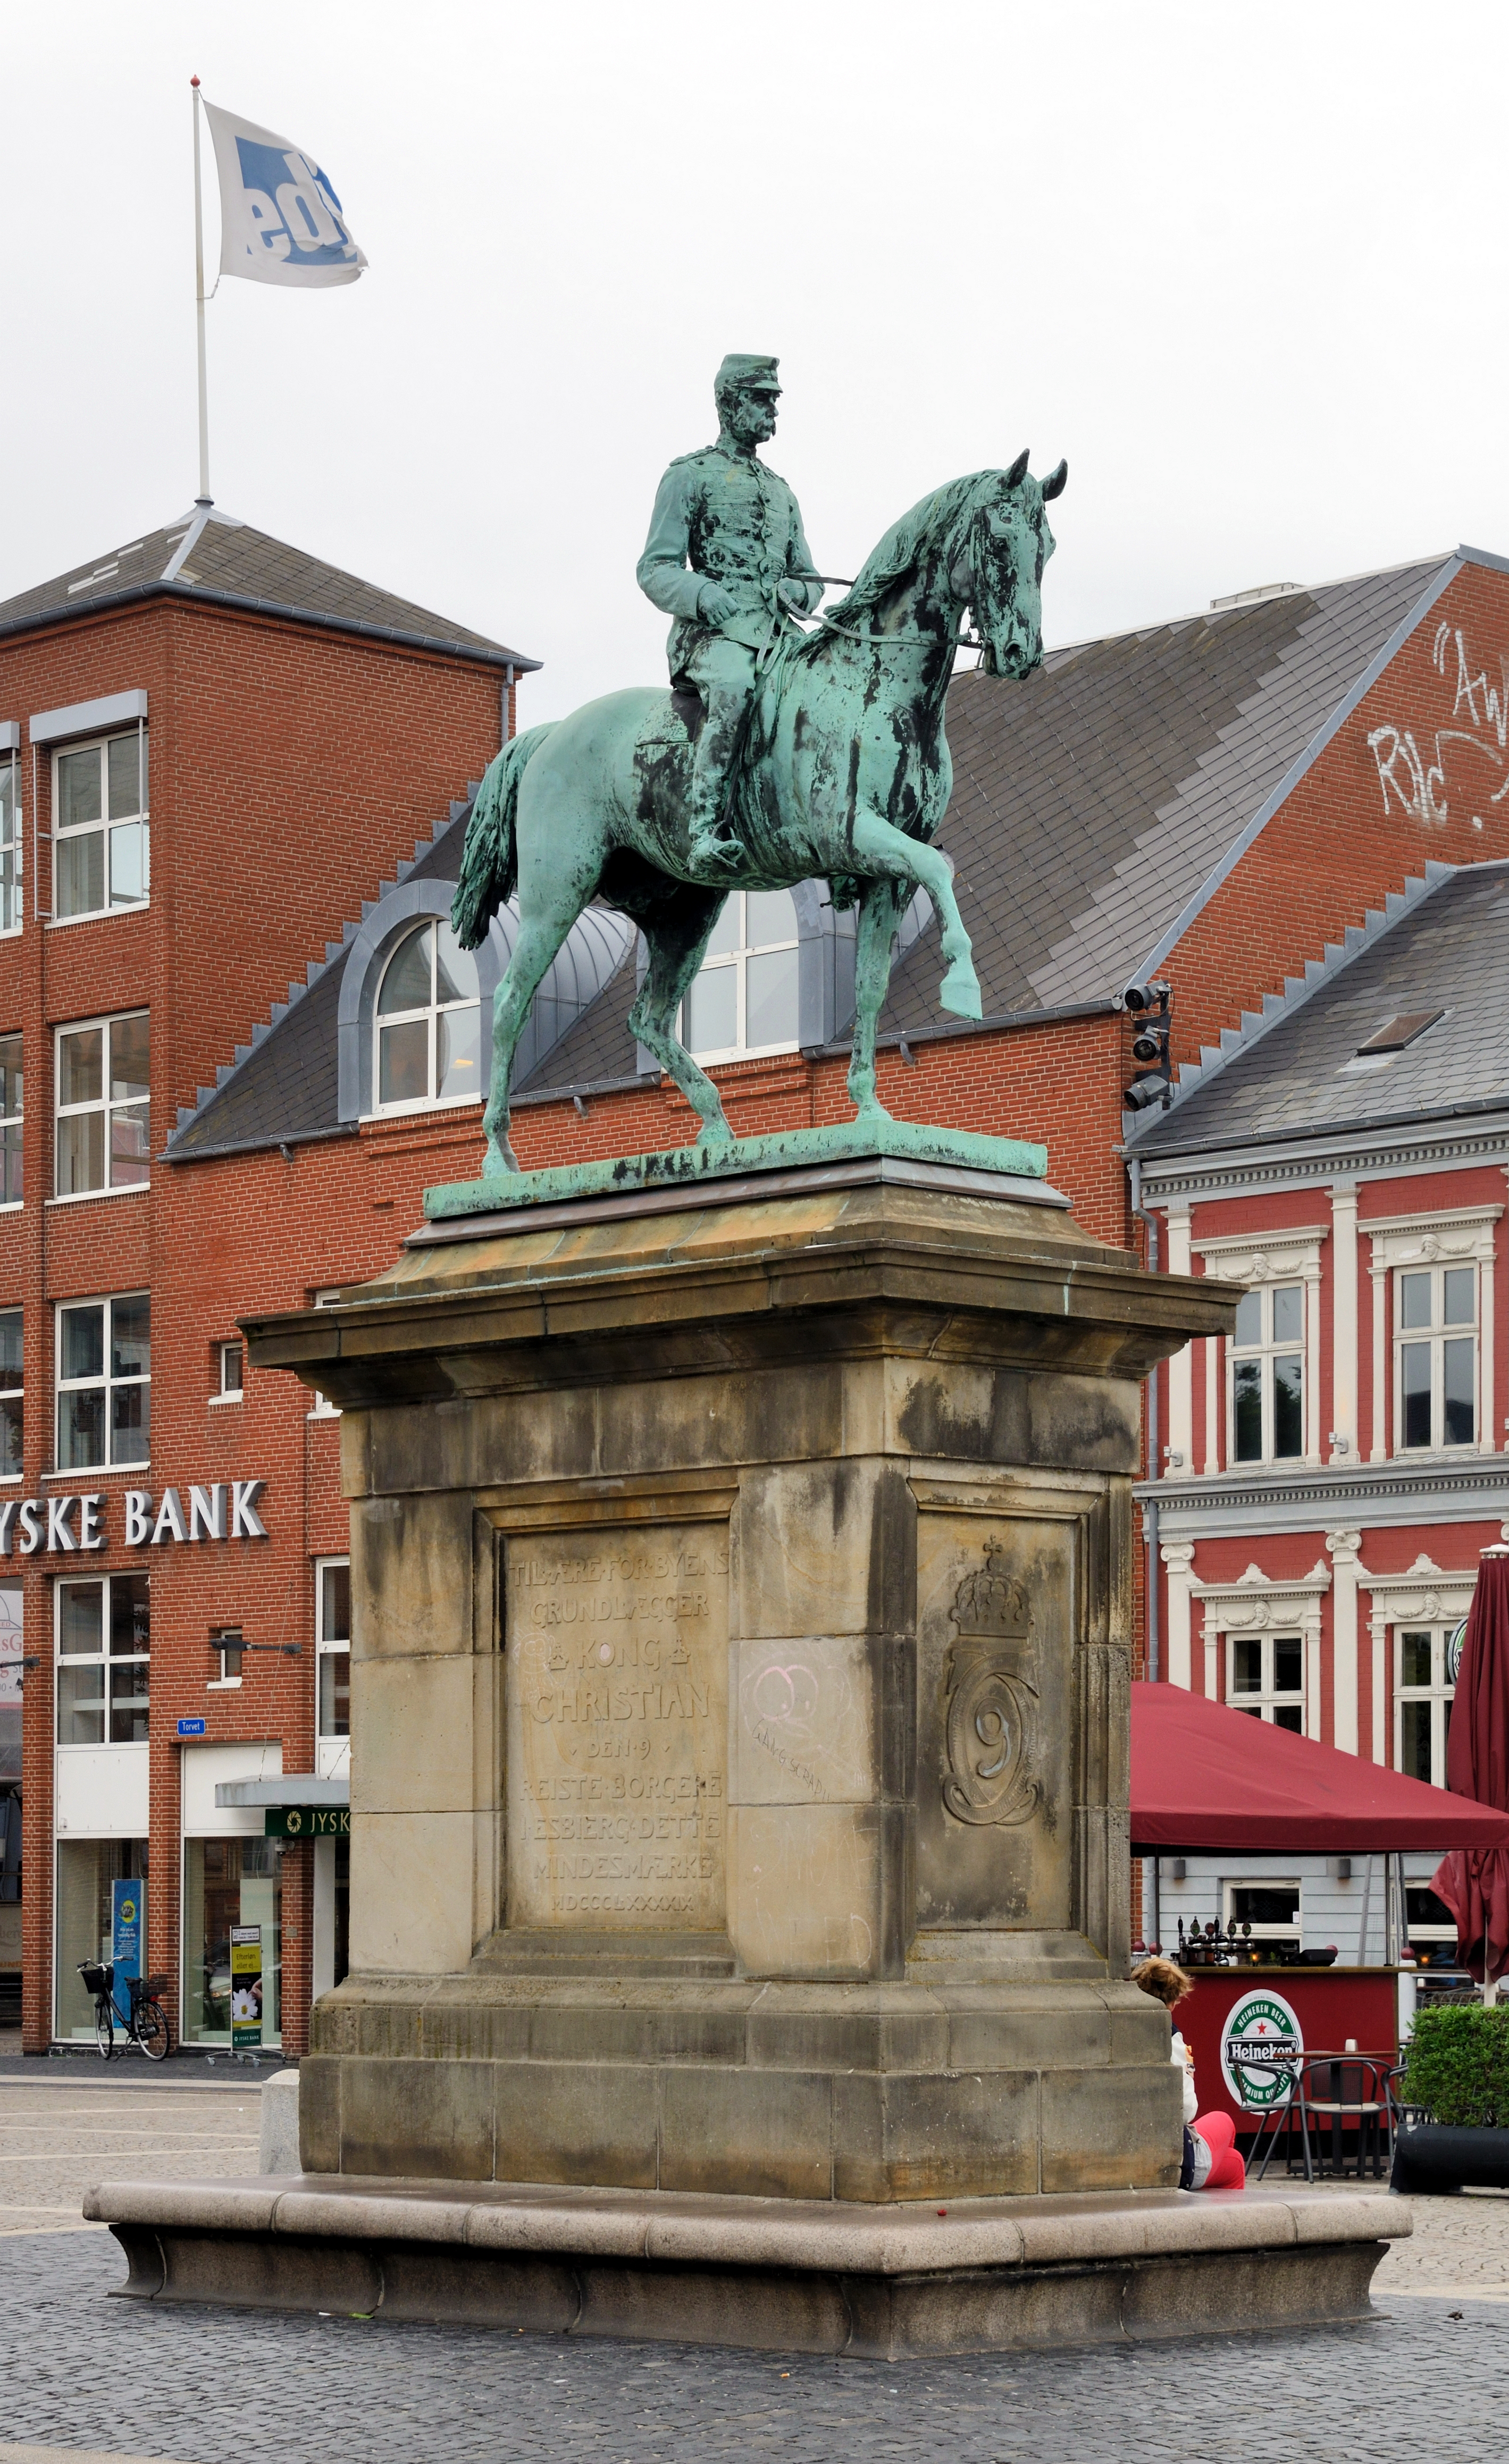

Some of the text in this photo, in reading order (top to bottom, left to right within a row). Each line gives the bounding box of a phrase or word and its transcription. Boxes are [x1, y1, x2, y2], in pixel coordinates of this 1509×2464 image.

[124, 1480, 269, 1546] BANK
[607, 1554, 650, 1582] FOR
[654, 1549, 730, 1579] BYENS
[577, 1636, 660, 1671] KONG
[532, 1684, 710, 1723] CHRISTIAN
[182, 1721, 200, 1731] Torvet
[587, 1738, 631, 1758] DEN
[519, 1771, 723, 1804] REISTE BORGERE
[639, 1812, 722, 1839] DETTE
[533, 1853, 712, 1879] MINDESMÆRKE
[1237, 2004, 1286, 2028] HEINEKEN BEER
